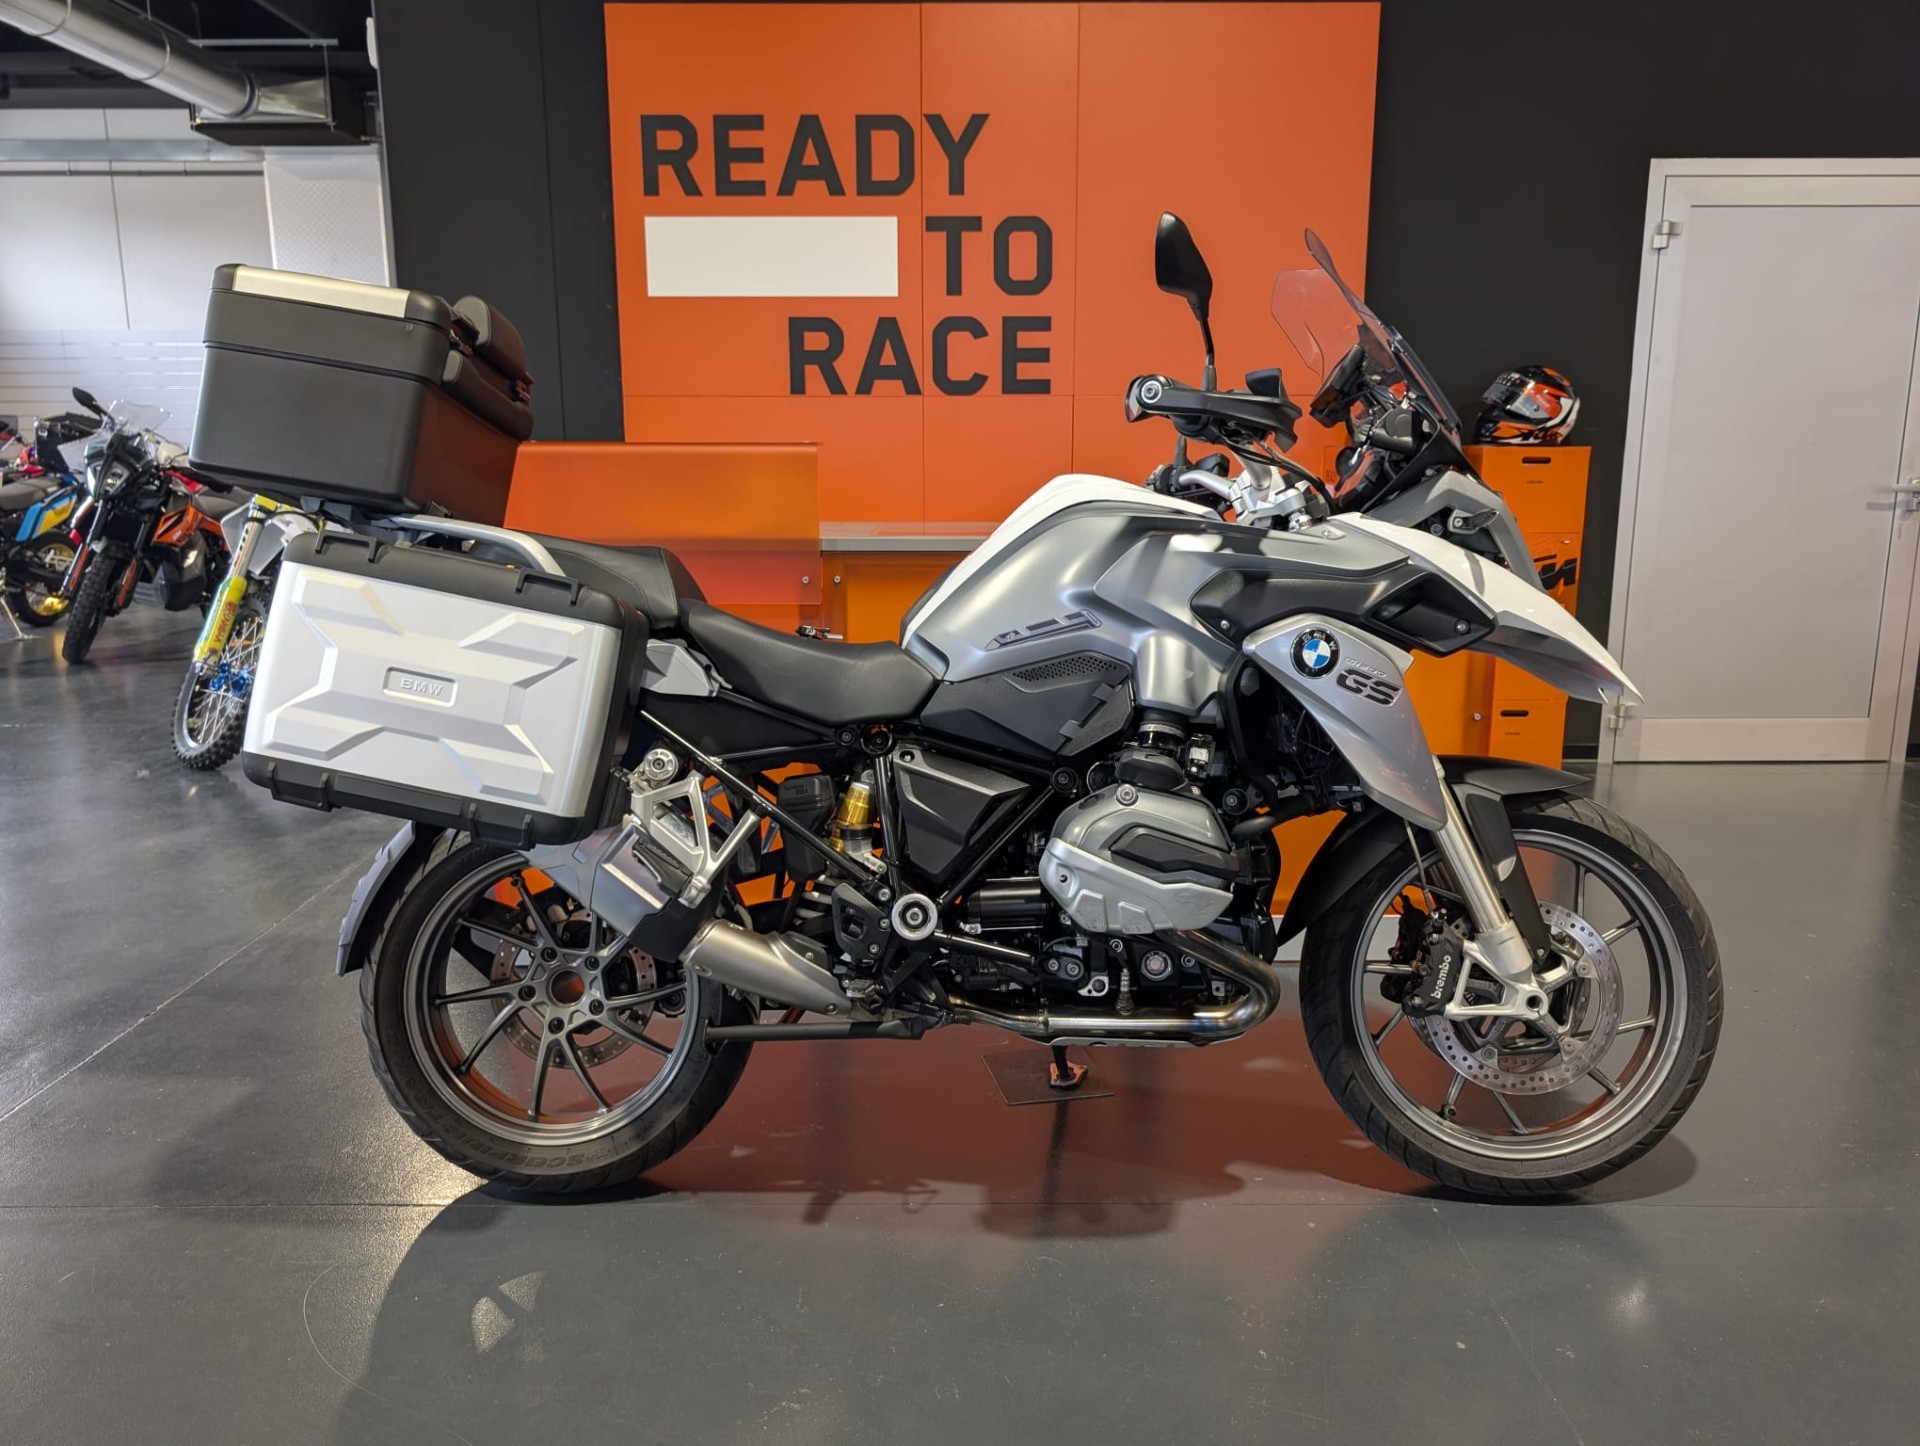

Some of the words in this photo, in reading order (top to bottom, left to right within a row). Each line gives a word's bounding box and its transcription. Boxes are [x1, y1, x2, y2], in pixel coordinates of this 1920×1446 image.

[640, 113, 990, 197] READY
[925, 216, 1053, 296] TO
[788, 316, 1052, 395] RACE
[1302, 631, 1338, 651] BMW
[401, 678, 443, 696] BMW
[1336, 669, 1401, 705] GS
[1430, 955, 1452, 999] brembo
